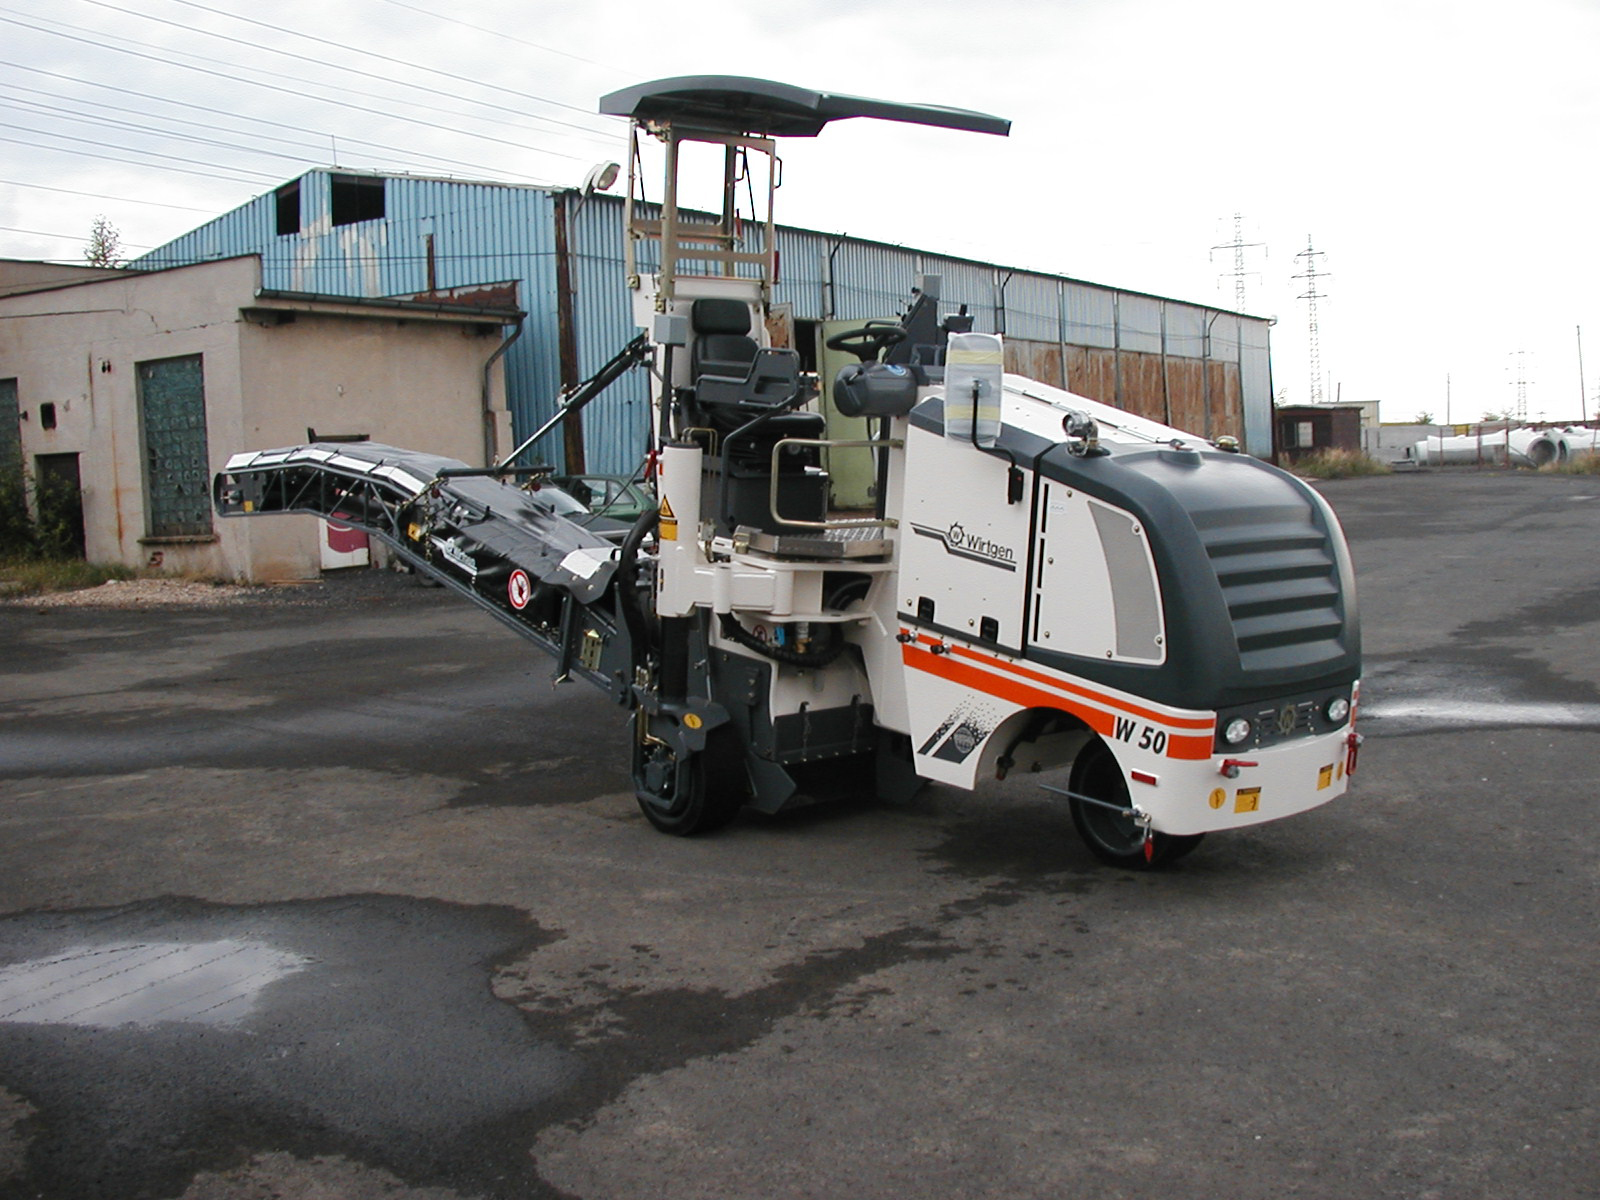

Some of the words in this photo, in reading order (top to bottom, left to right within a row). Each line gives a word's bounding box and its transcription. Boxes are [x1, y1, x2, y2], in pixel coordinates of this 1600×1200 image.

[967, 534, 1013, 559] Wirtgen
[1116, 716, 1136, 743] W
[1138, 726, 1166, 754] 50
